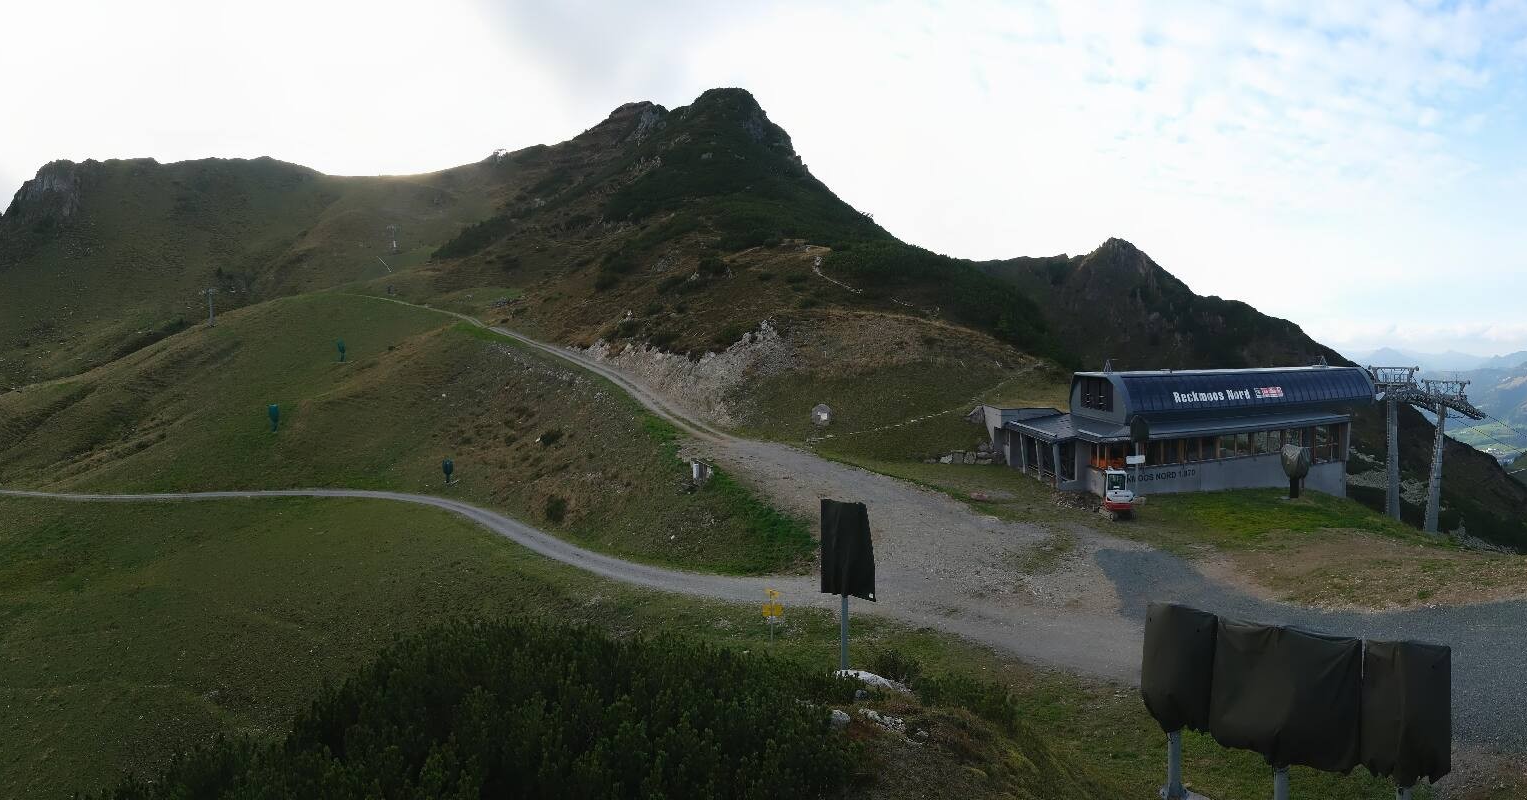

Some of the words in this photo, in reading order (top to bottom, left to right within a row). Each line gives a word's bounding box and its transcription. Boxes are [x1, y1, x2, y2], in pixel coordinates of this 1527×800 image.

[1173, 390, 1224, 403] Reckmoos
[1226, 389, 1251, 401] Nord
[1127, 473, 1154, 484] KMOOS
[1156, 471, 1177, 481] NORD
